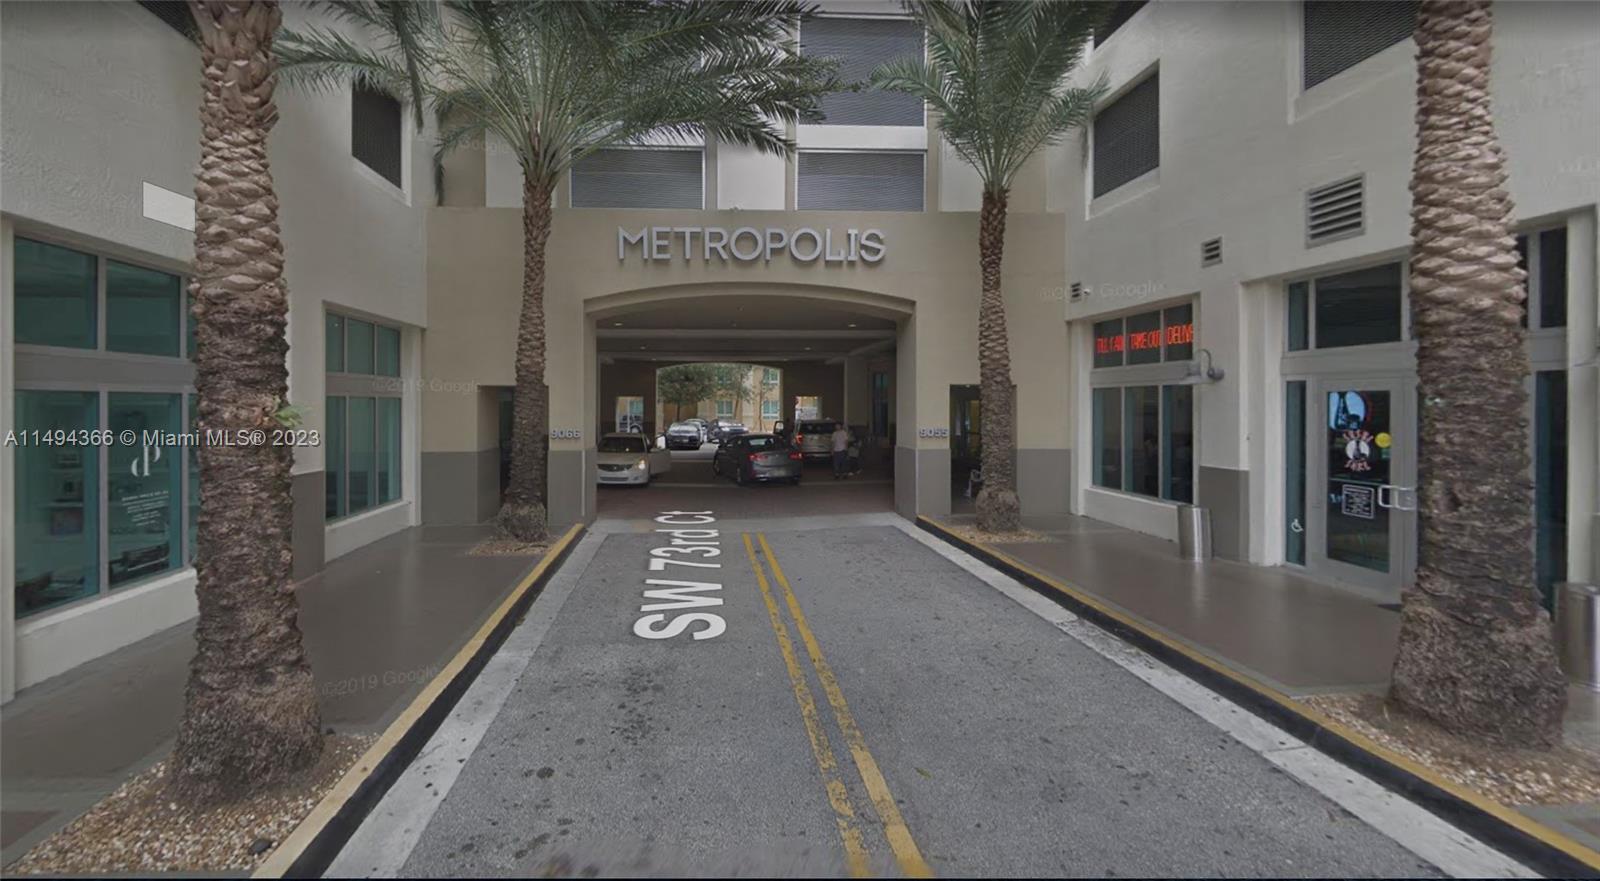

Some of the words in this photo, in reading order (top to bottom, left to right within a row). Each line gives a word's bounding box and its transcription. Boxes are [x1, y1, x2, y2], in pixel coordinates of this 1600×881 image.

[617, 226, 887, 263] METROPOLIS
[551, 428, 580, 439] 9066
[919, 427, 948, 437] 9055
